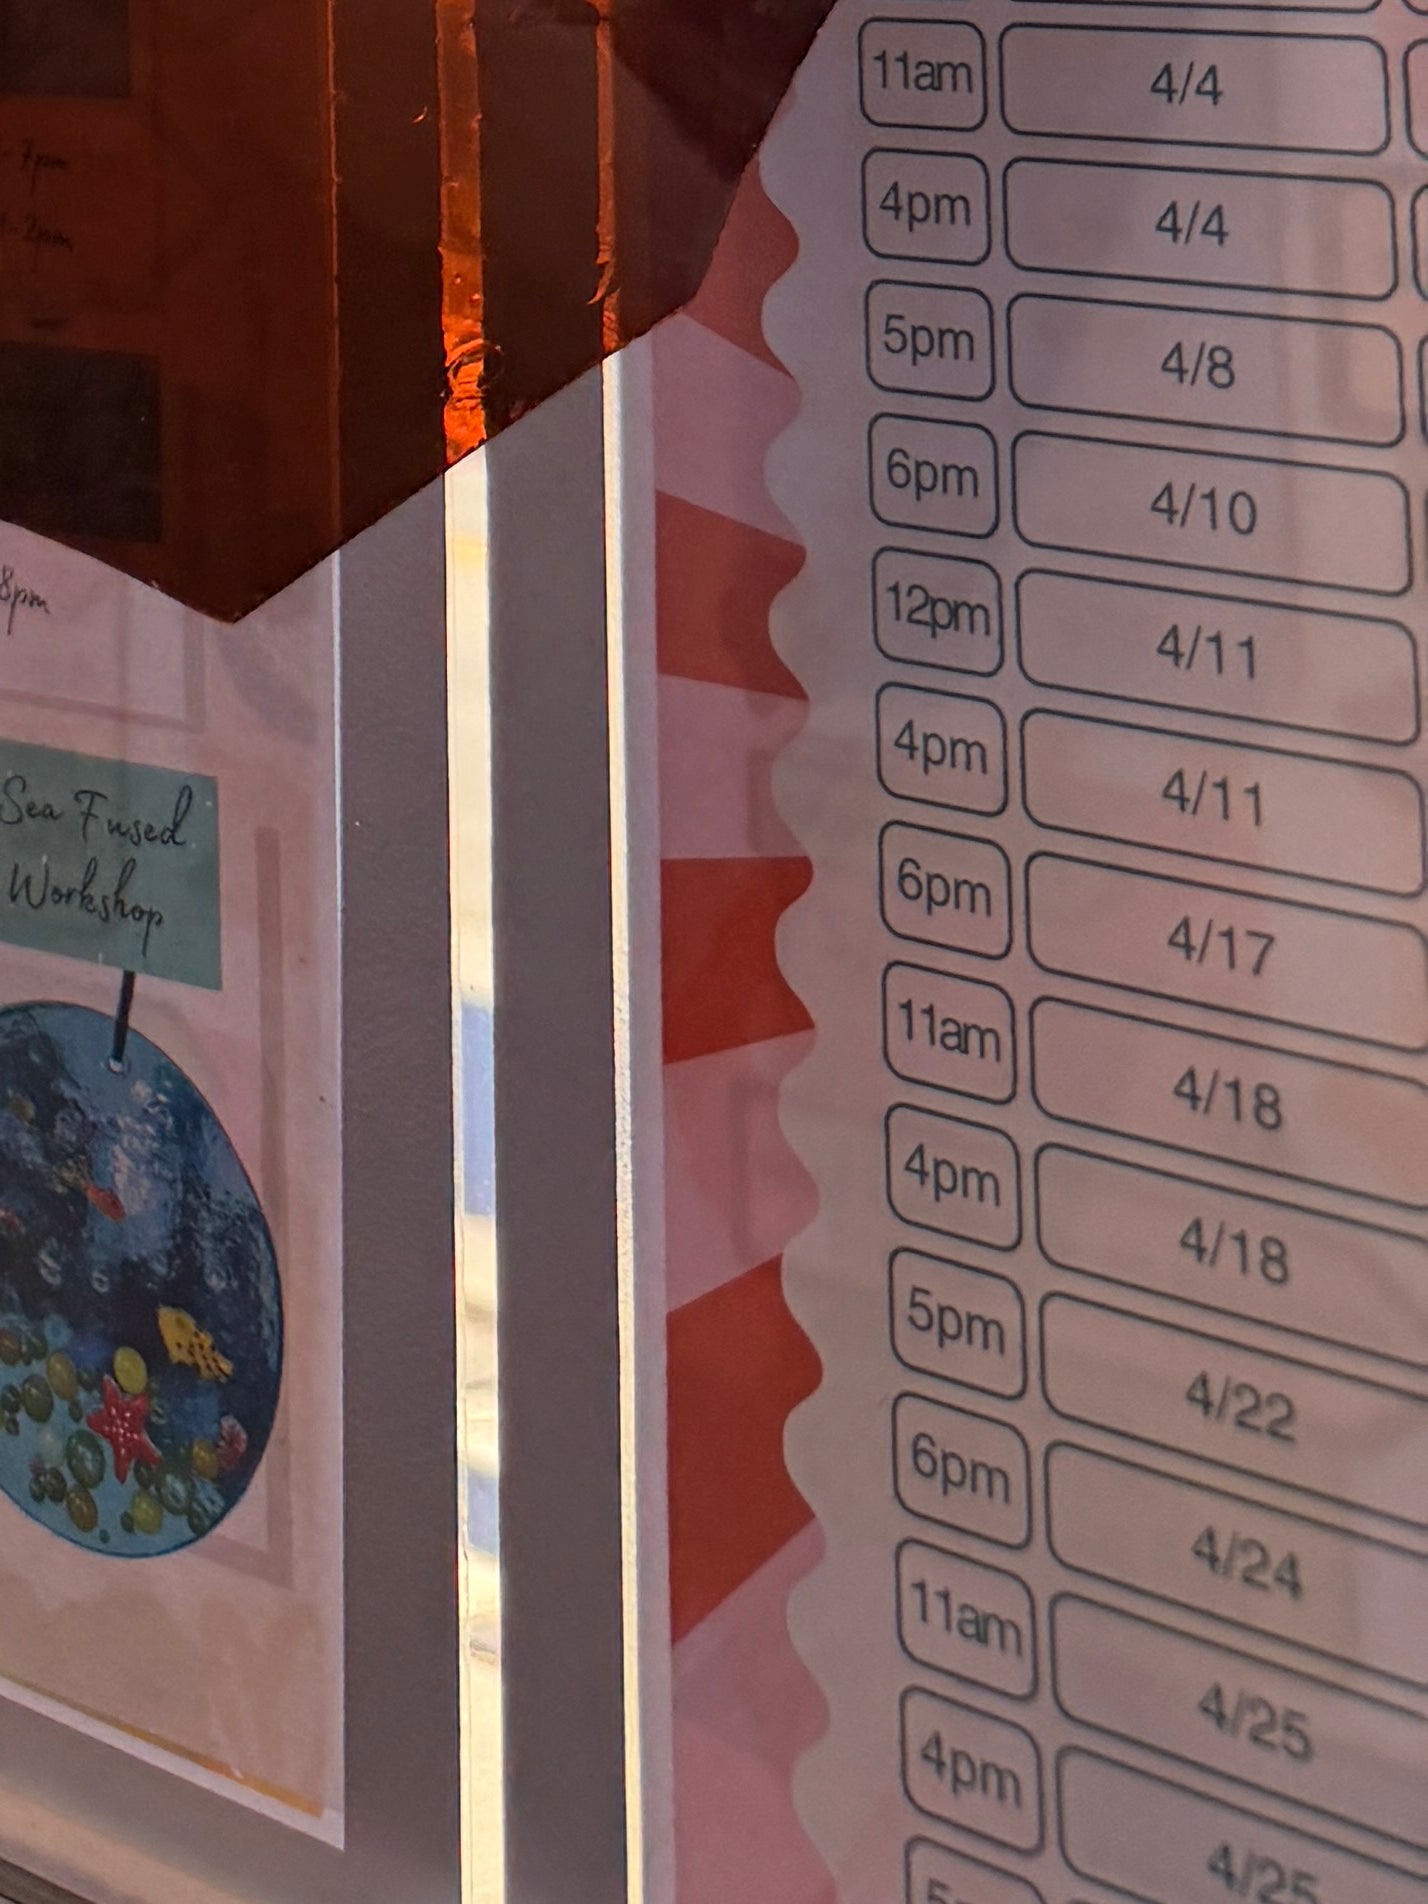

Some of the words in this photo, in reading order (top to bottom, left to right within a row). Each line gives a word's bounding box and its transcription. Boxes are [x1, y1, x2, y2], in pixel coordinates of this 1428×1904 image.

[873, 49, 973, 94] 11am
[1150, 62, 1223, 106] 4/4
[879, 181, 971, 233] 4pm
[1155, 201, 1229, 246] 4/4
[884, 313, 975, 366] 5pm
[1160, 341, 1236, 390] 4/8
[887, 447, 979, 502] 6pm
[1150, 482, 1257, 536] 4/10
[887, 581, 991, 639] 12pm
[1156, 624, 1255, 680] 4/11
[893, 719, 988, 775] 4pm
[74, 784, 194, 848] Fused
[1161, 769, 1262, 827] 4/11
[8, 858, 164, 958] Workshop
[897, 857, 992, 917] 6pm
[1167, 916, 1276, 977] 4/17
[899, 998, 1001, 1062] 11am
[1173, 1066, 1283, 1132] 4/18
[904, 1143, 1001, 1207] 4pm
[1179, 1217, 1290, 1286] 4/18
[907, 1288, 1006, 1357] 5pm
[1185, 1368, 1297, 1444] 4/22
[910, 1430, 1011, 1505] 6pm
[1191, 1522, 1305, 1603] 4/24
[910, 1578, 1024, 1657] 11am
[1197, 1680, 1315, 1765] 4/25
[919, 1729, 1024, 1810] 4pm
